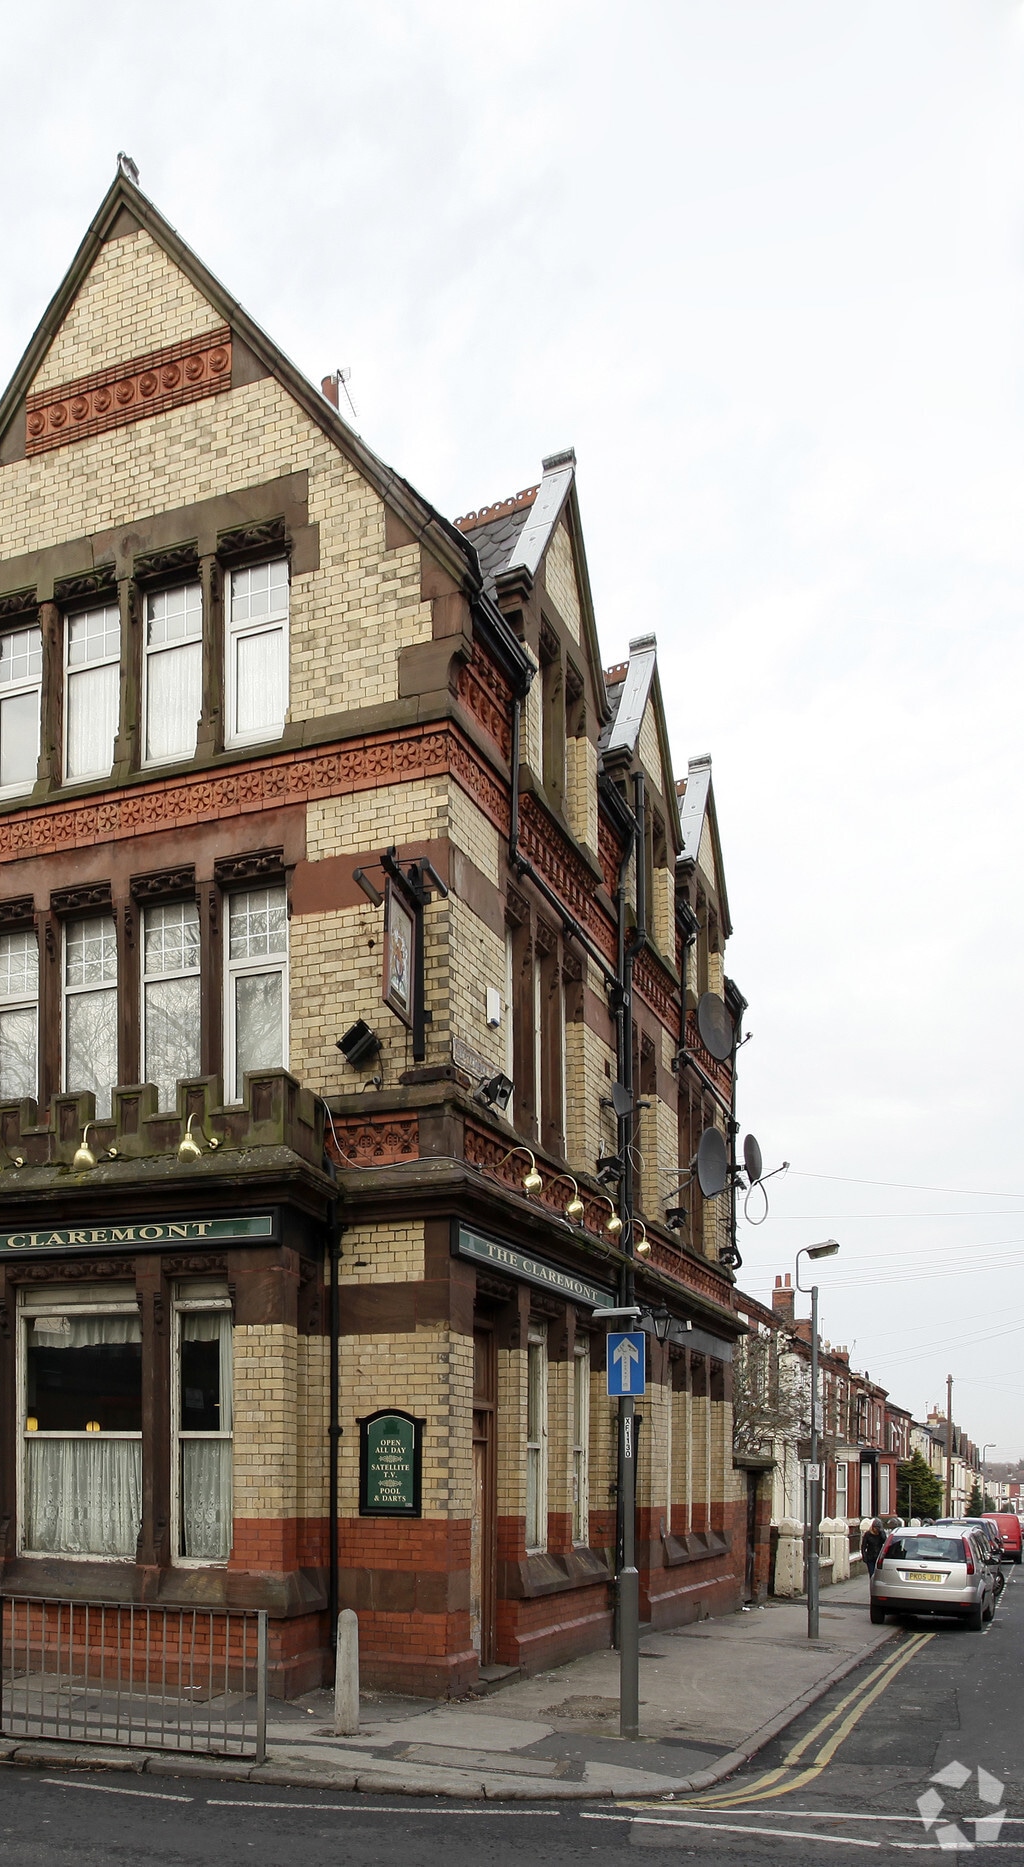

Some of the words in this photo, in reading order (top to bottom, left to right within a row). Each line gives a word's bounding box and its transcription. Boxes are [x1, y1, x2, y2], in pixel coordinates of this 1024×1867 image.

[6, 1221, 213, 1249] CLAREMONT
[486, 1243, 519, 1267] THE
[522, 1259, 598, 1301] CLAREMONT
